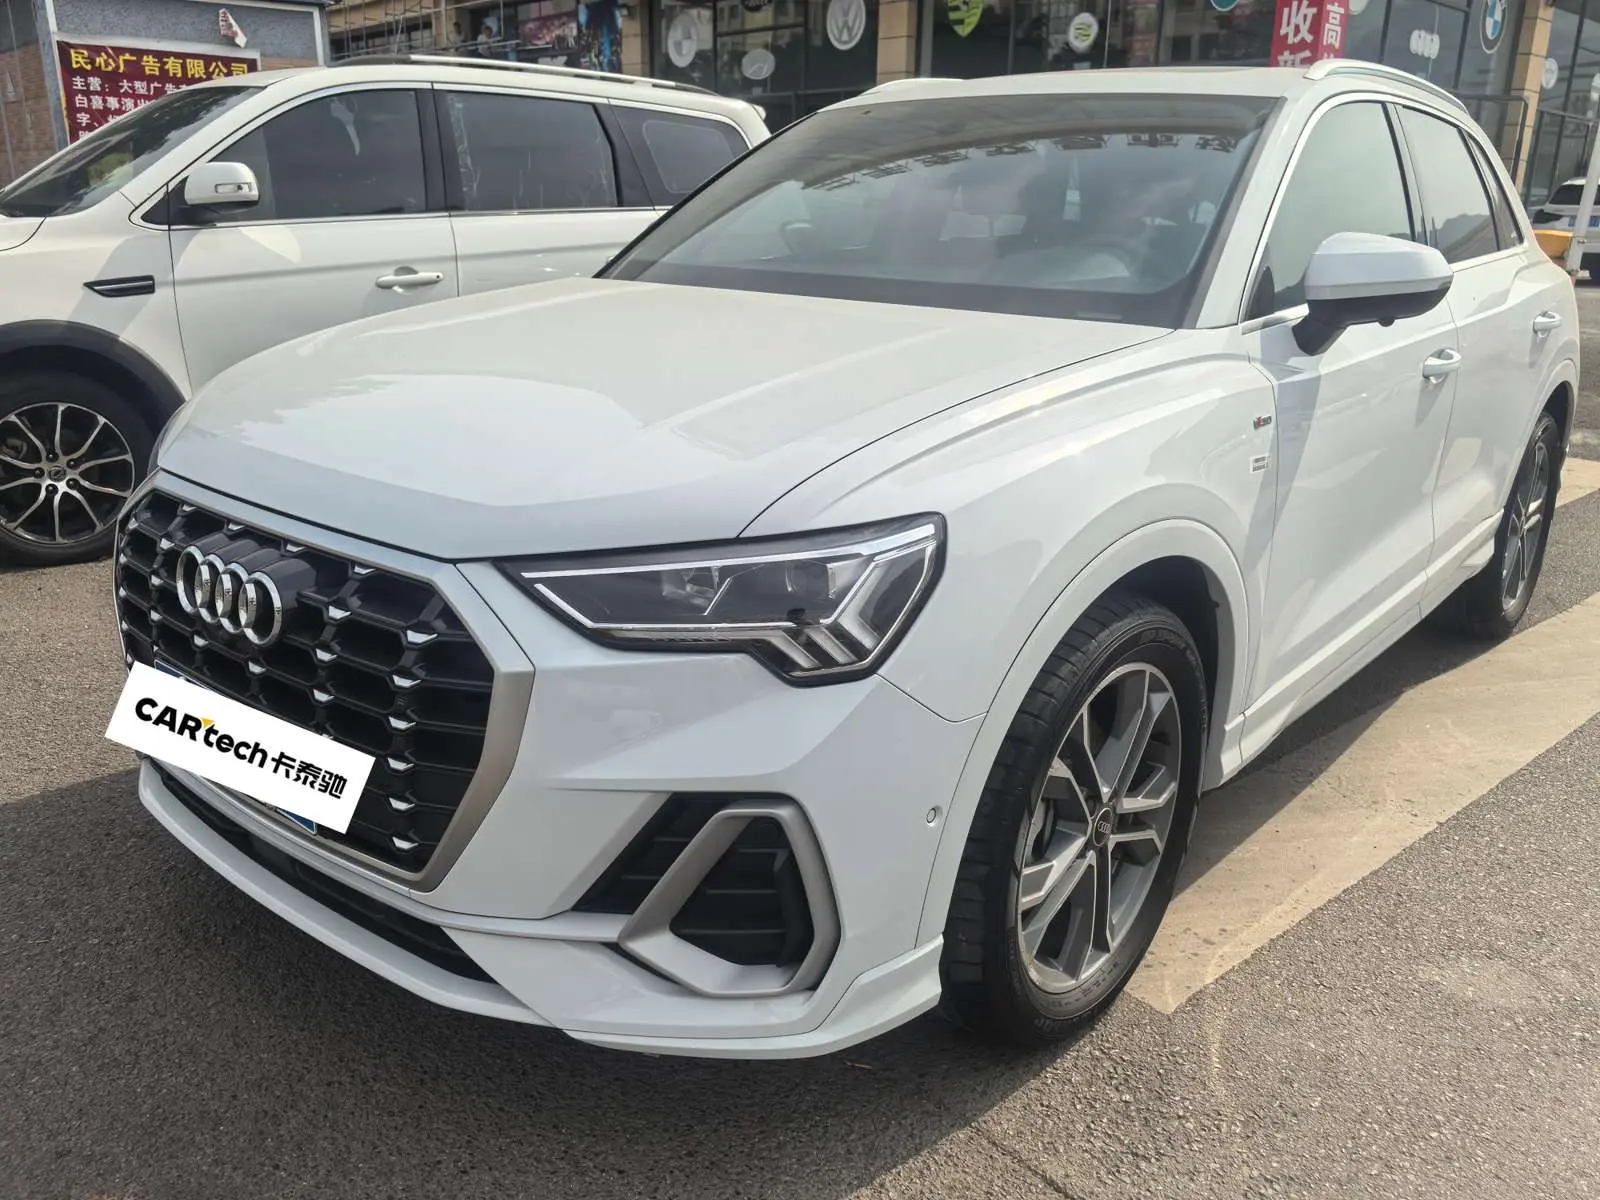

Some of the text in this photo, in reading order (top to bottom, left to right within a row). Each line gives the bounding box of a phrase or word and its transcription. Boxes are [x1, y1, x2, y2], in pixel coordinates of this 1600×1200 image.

[70, 48, 248, 79] 民心广告有限公司
